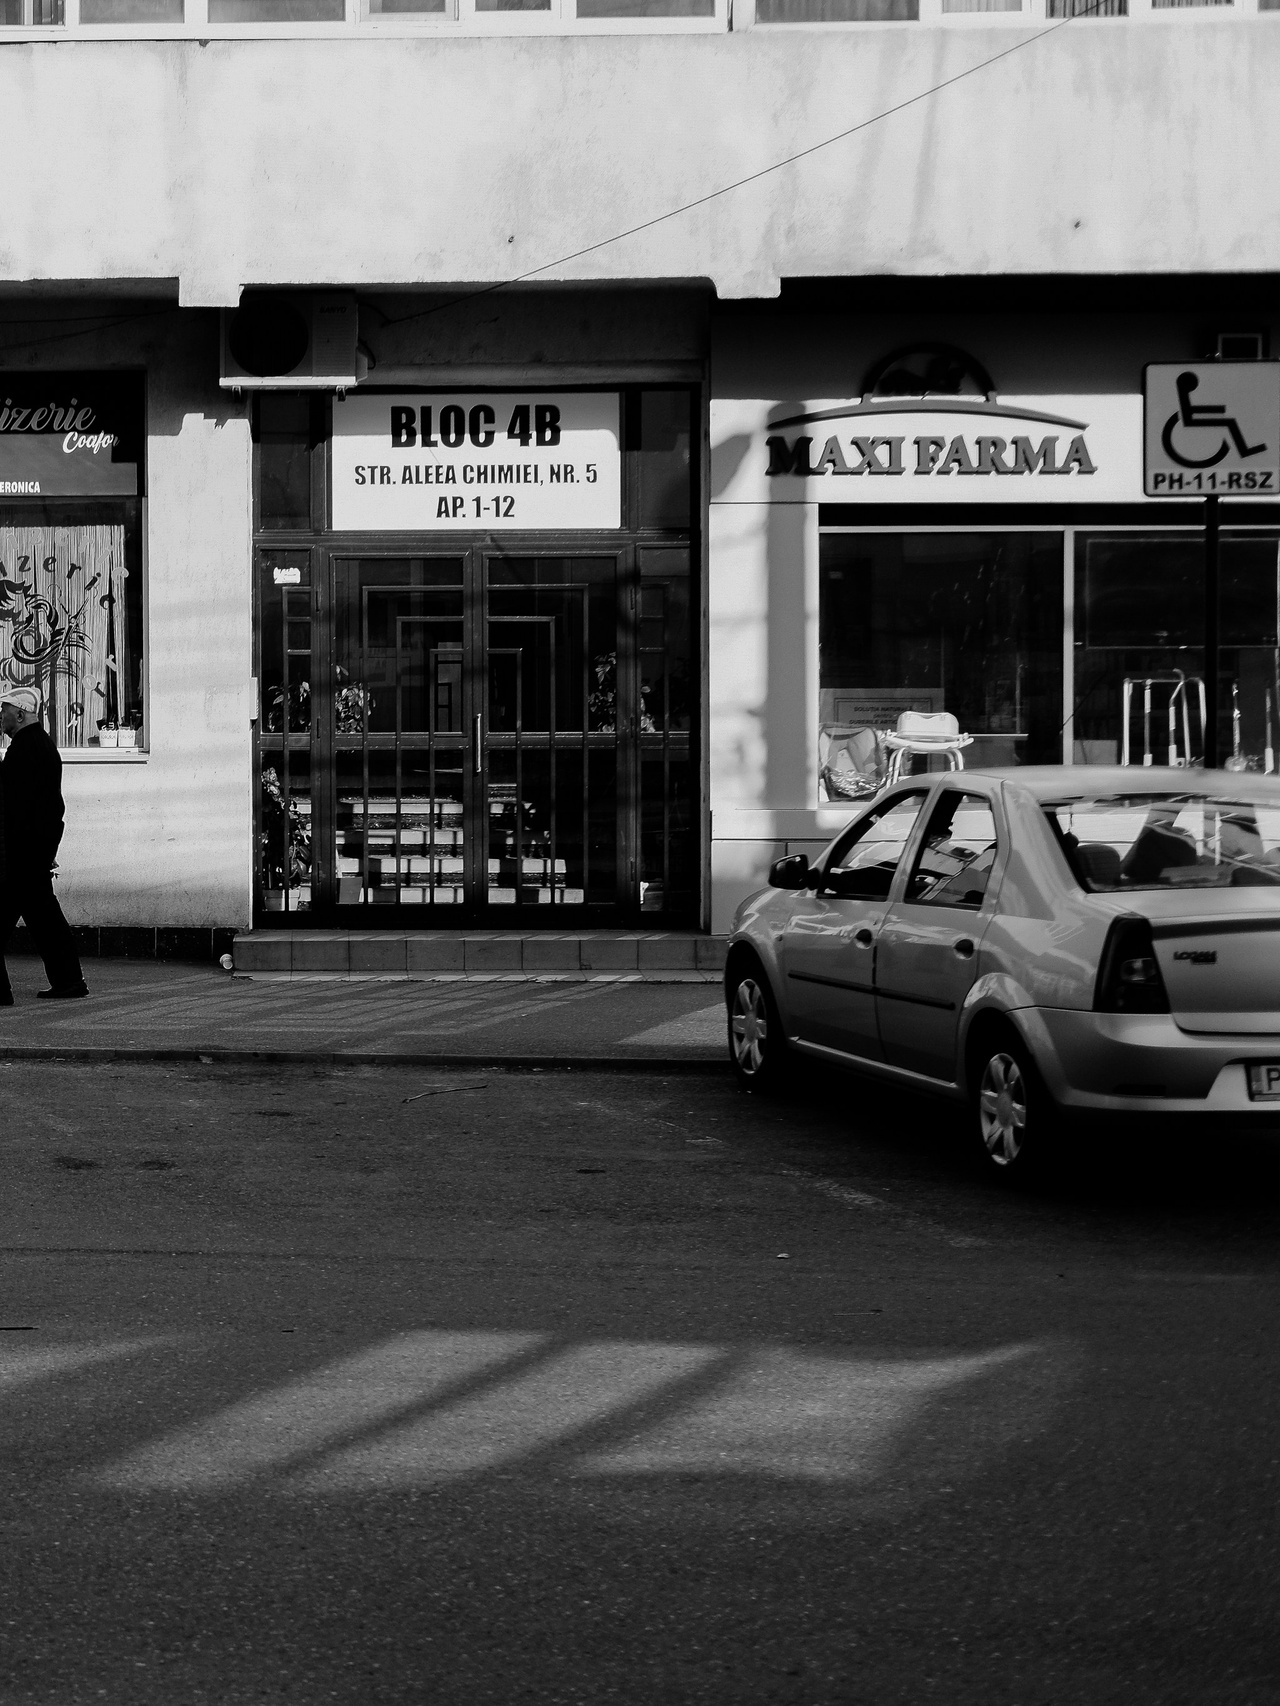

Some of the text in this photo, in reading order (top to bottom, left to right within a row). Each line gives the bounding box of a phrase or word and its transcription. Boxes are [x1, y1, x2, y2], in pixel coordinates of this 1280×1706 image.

[391, 404, 561, 448] BLOC 4B
[354, 463, 598, 486] STR. ALEEA CHIMIEI, NR. 5
[1153, 471, 1273, 490] PH-11-RSZ
[436, 495, 515, 518] AP. 1-12
